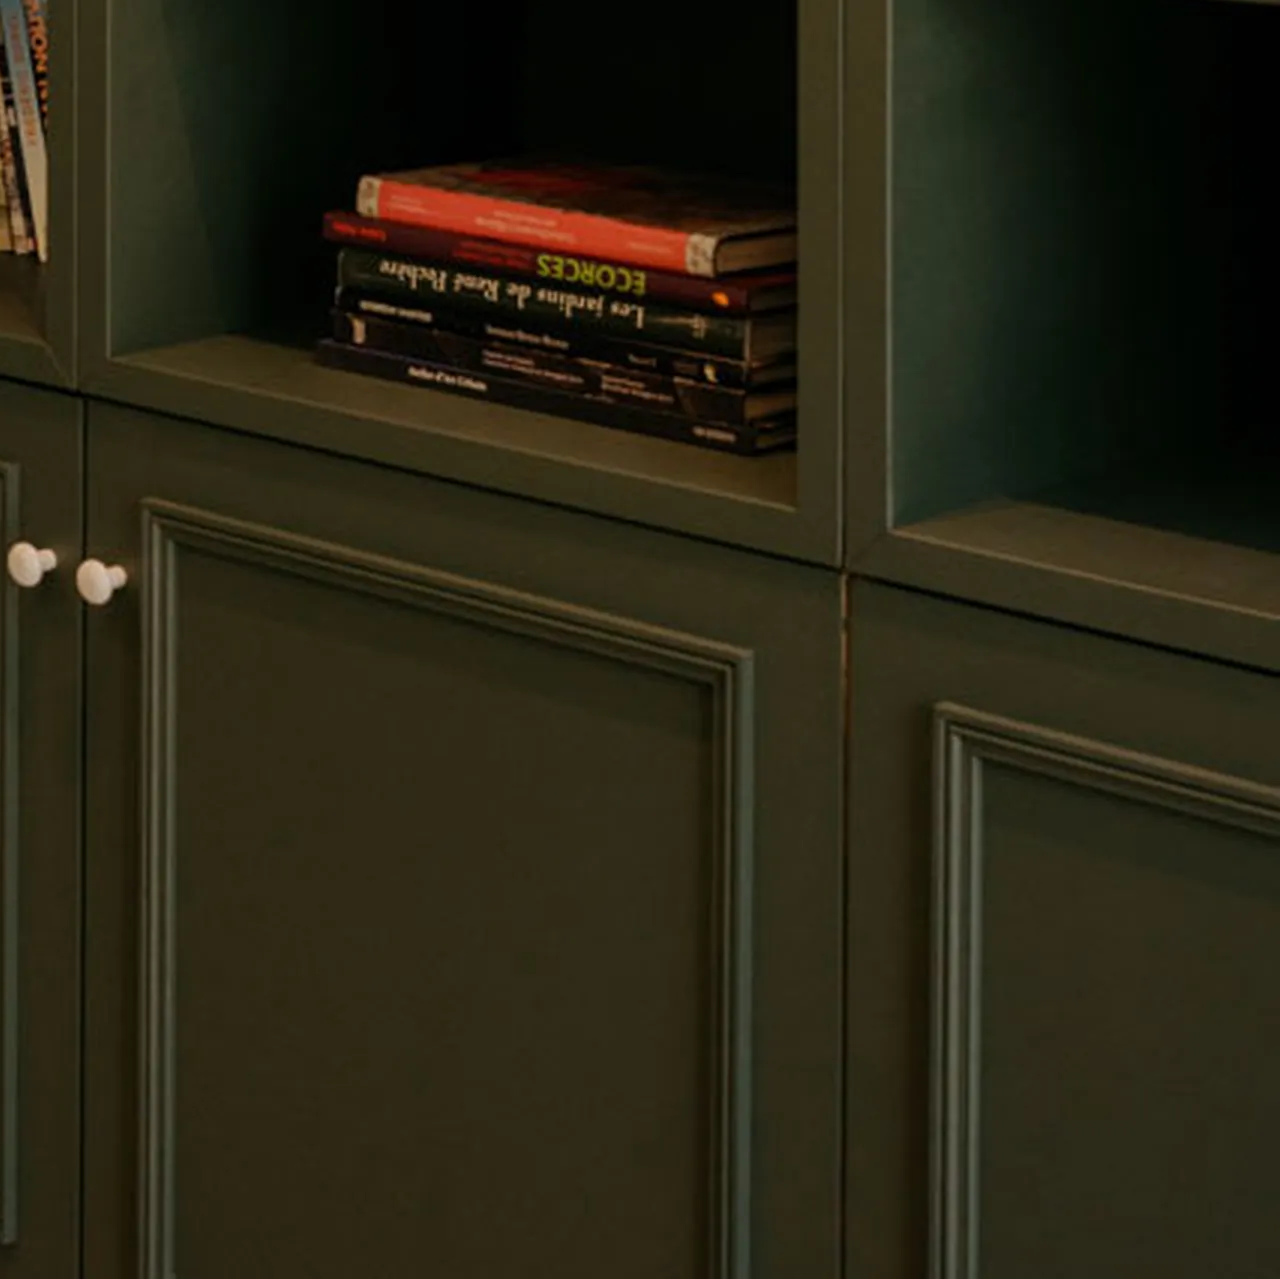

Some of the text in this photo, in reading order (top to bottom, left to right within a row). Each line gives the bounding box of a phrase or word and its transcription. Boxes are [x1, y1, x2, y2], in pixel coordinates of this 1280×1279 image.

[452, 271, 500, 303] René
[536, 252, 648, 297] ECORCES
[506, 282, 533, 309] de
[536, 286, 607, 320] jardins
[610, 297, 646, 330] Les
